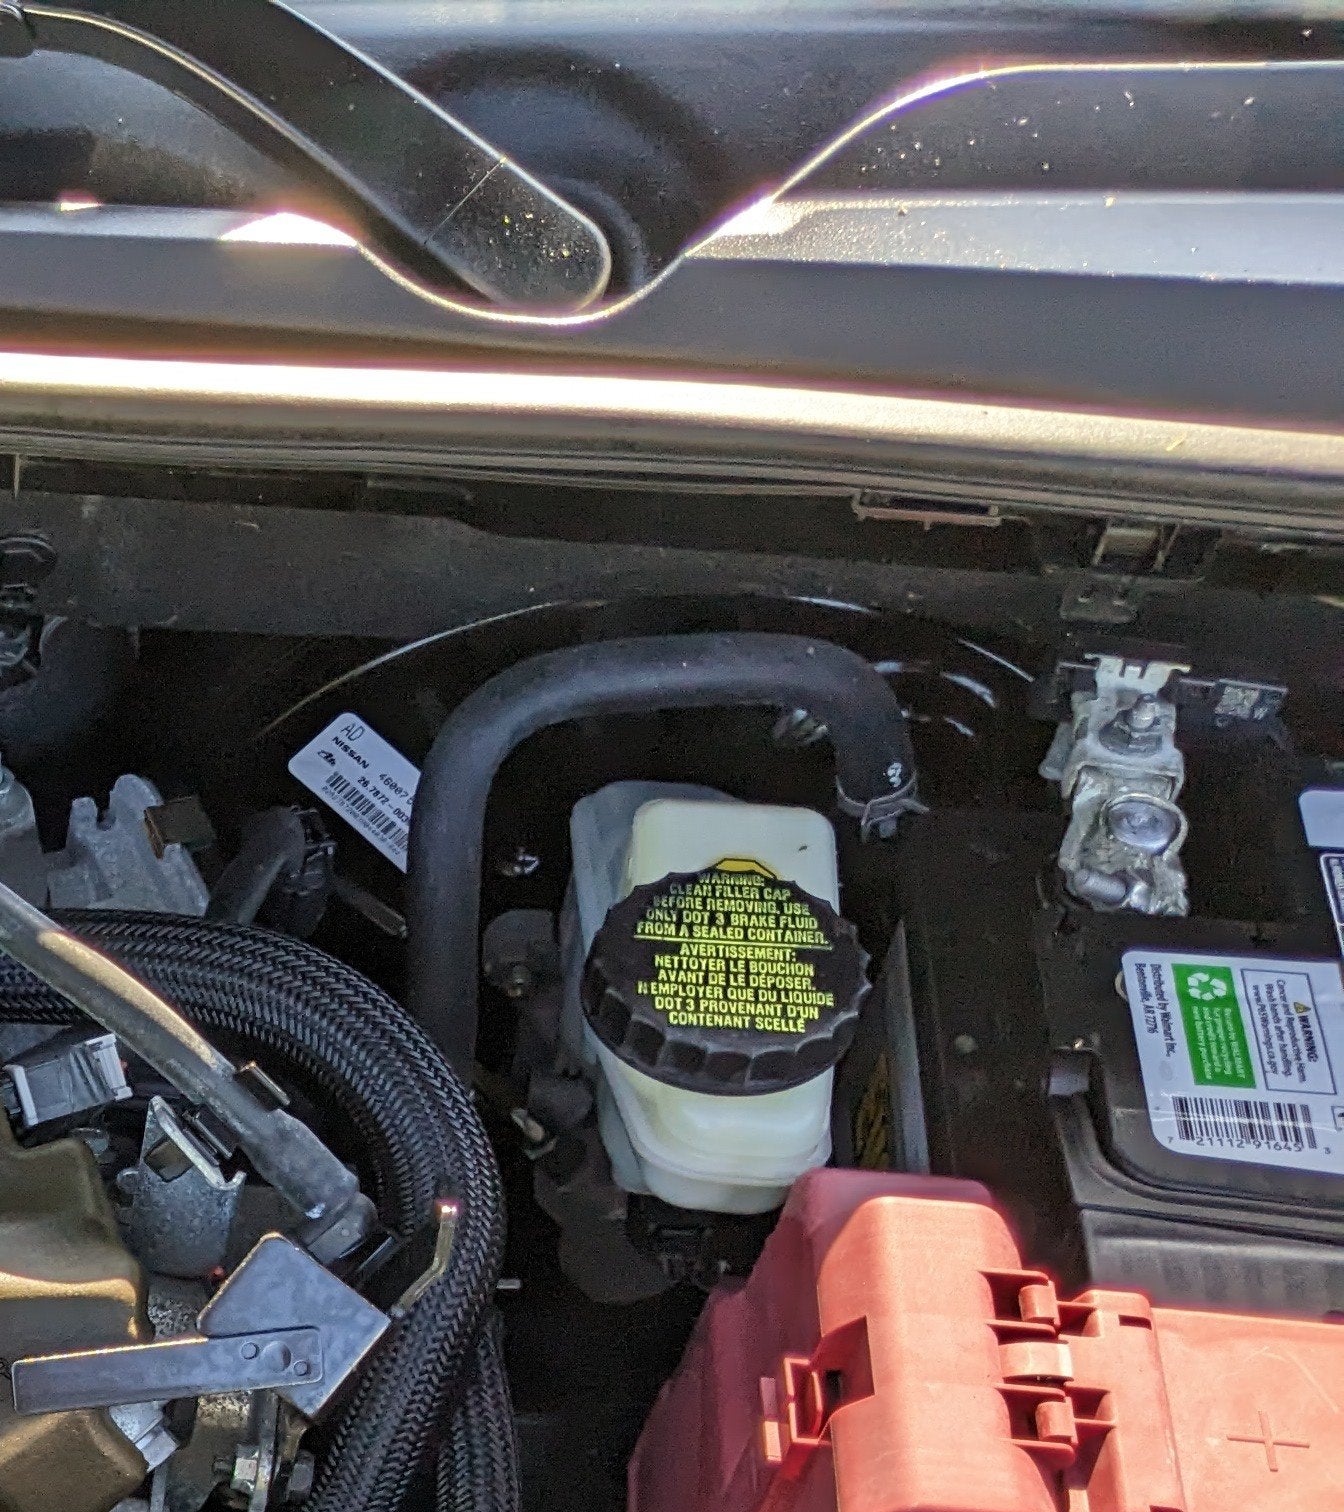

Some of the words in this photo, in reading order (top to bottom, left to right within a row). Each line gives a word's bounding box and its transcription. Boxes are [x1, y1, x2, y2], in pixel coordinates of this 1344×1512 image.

[332, 736, 370, 770] NISSAN
[699, 872, 765, 886] WARNING:
[670, 884, 712, 897] CLEAN
[715, 885, 760, 899] FILLER
[763, 887, 791, 900] CAP
[654, 896, 704, 910] BEFORE
[706, 899, 780, 915] REMOVING.
[783, 902, 810, 916] USE
[646, 909, 680, 923] ONLY
[682, 911, 710, 924] DOT
[715, 912, 724, 925] 3
[730, 914, 776, 928] BRAKE
[779, 915, 818, 930] FLUID
[637, 922, 675, 936] FROM
[679, 925, 689, 937] A
[693, 925, 745, 940] SEALED
[747, 928, 829, 945] CONTAINER.
[679, 943, 796, 962] AVERTISSEMENT:
[654, 955, 725, 971] NETTOYER
[729, 959, 745, 972] LE
[749, 960, 814, 977] BOUCHON
[657, 970, 704, 984] AVANT
[709, 973, 725, 985] DE
[729, 974, 745, 986] LE
[654, 997, 682, 1010] DOT
[686, 998, 695, 1011] 3
[699, 1000, 782, 1016] PROVENANT
[727, 988, 755, 1002] QUE
[758, 989, 777, 1003] DU
[781, 990, 834, 1006] LIQUIDE
[668, 1012, 749, 1029] CONTENANT
[755, 1015, 806, 1033] SCELLÉ
